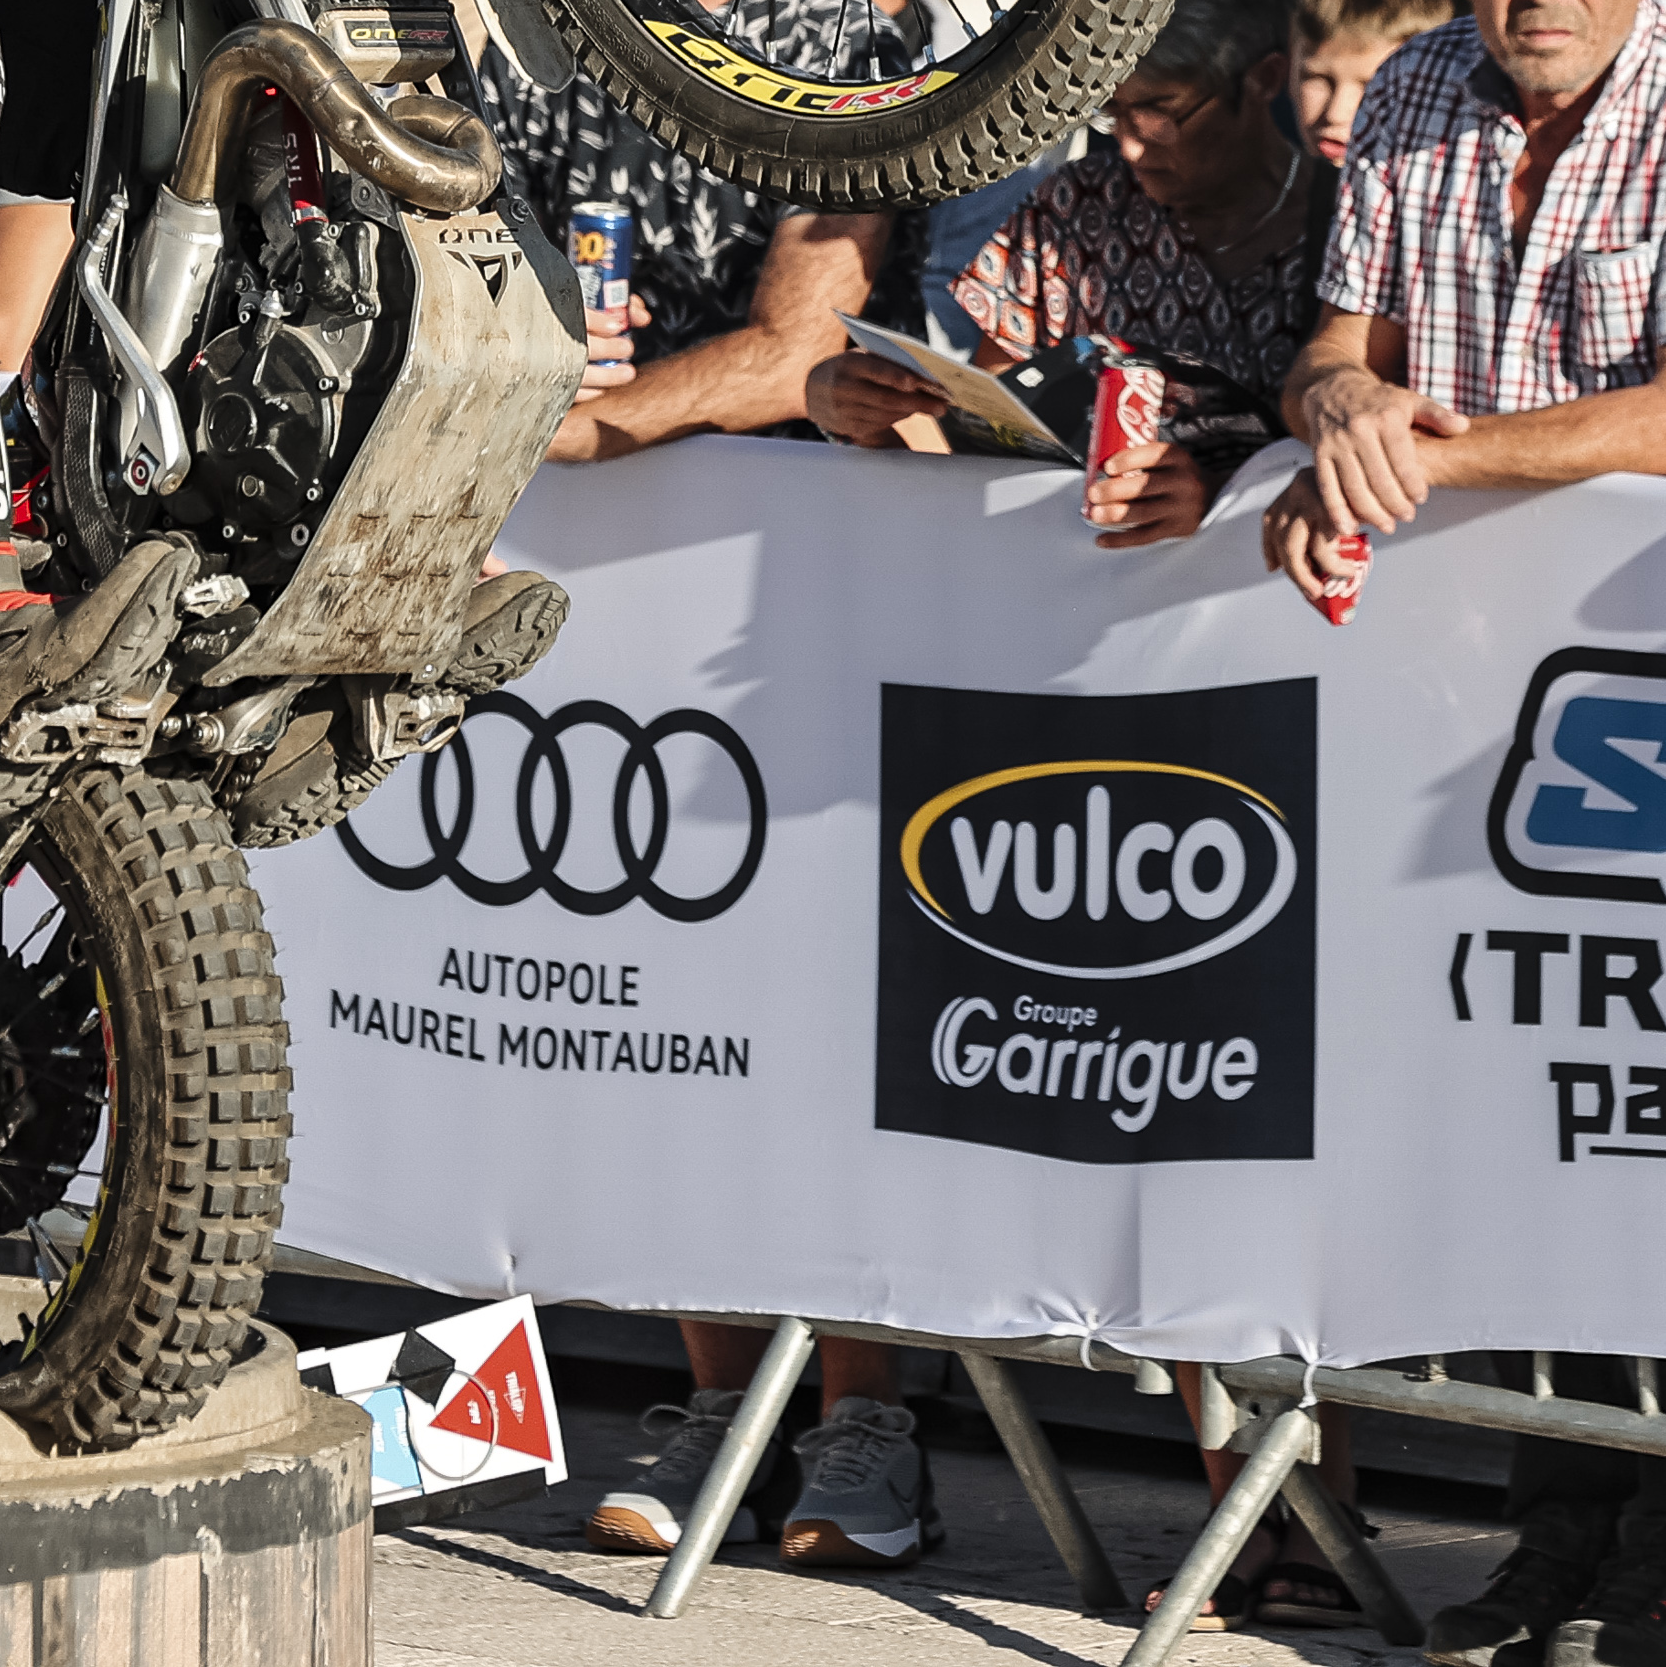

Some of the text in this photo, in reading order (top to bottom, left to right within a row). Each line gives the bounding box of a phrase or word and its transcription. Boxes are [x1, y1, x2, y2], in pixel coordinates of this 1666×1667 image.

[950, 784, 1246, 921] vulco
[439, 947, 640, 1009] AUTOPOLE
[1013, 995, 1097, 1031] Groupe
[330, 989, 751, 1079] MAUREL MONTAUBAN
